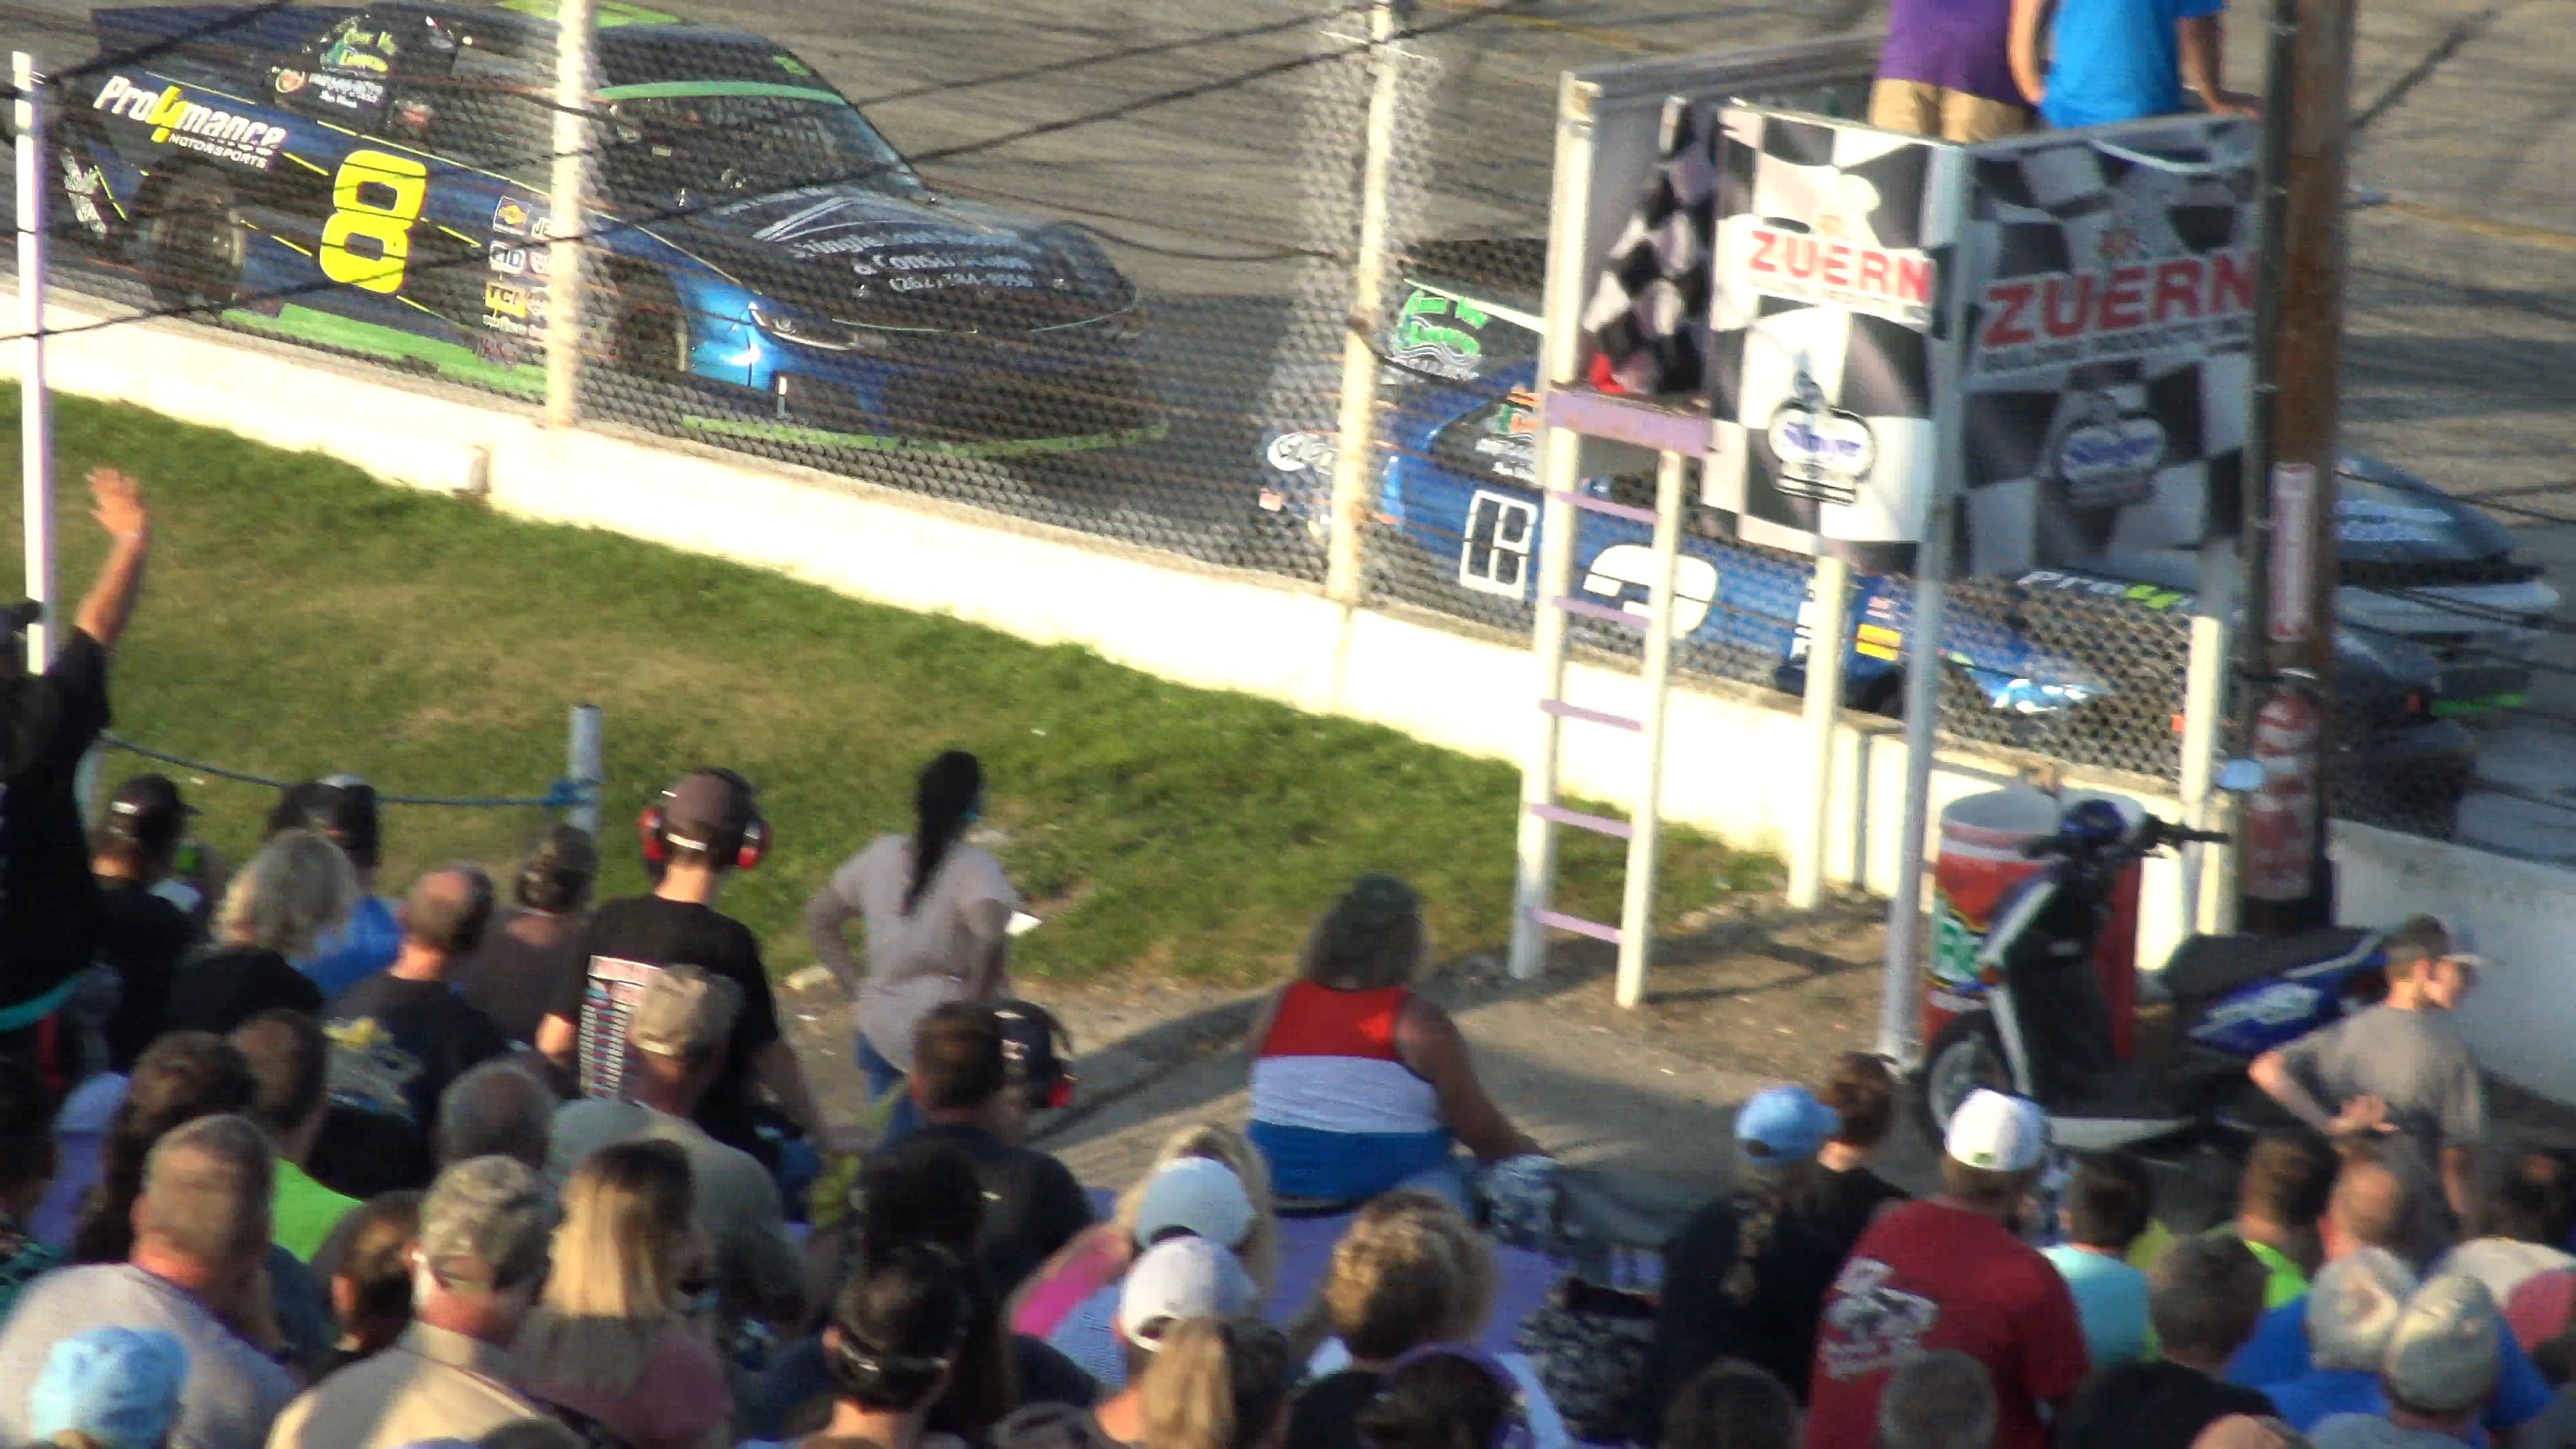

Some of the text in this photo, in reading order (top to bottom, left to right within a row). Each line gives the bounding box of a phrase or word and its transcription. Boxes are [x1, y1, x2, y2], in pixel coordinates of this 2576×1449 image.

[168, 134, 268, 168] MOTORSPORTS
[319, 150, 427, 294] 8
[1748, 229, 1933, 303] ZUERN
[1984, 255, 2256, 347] ZUERN
